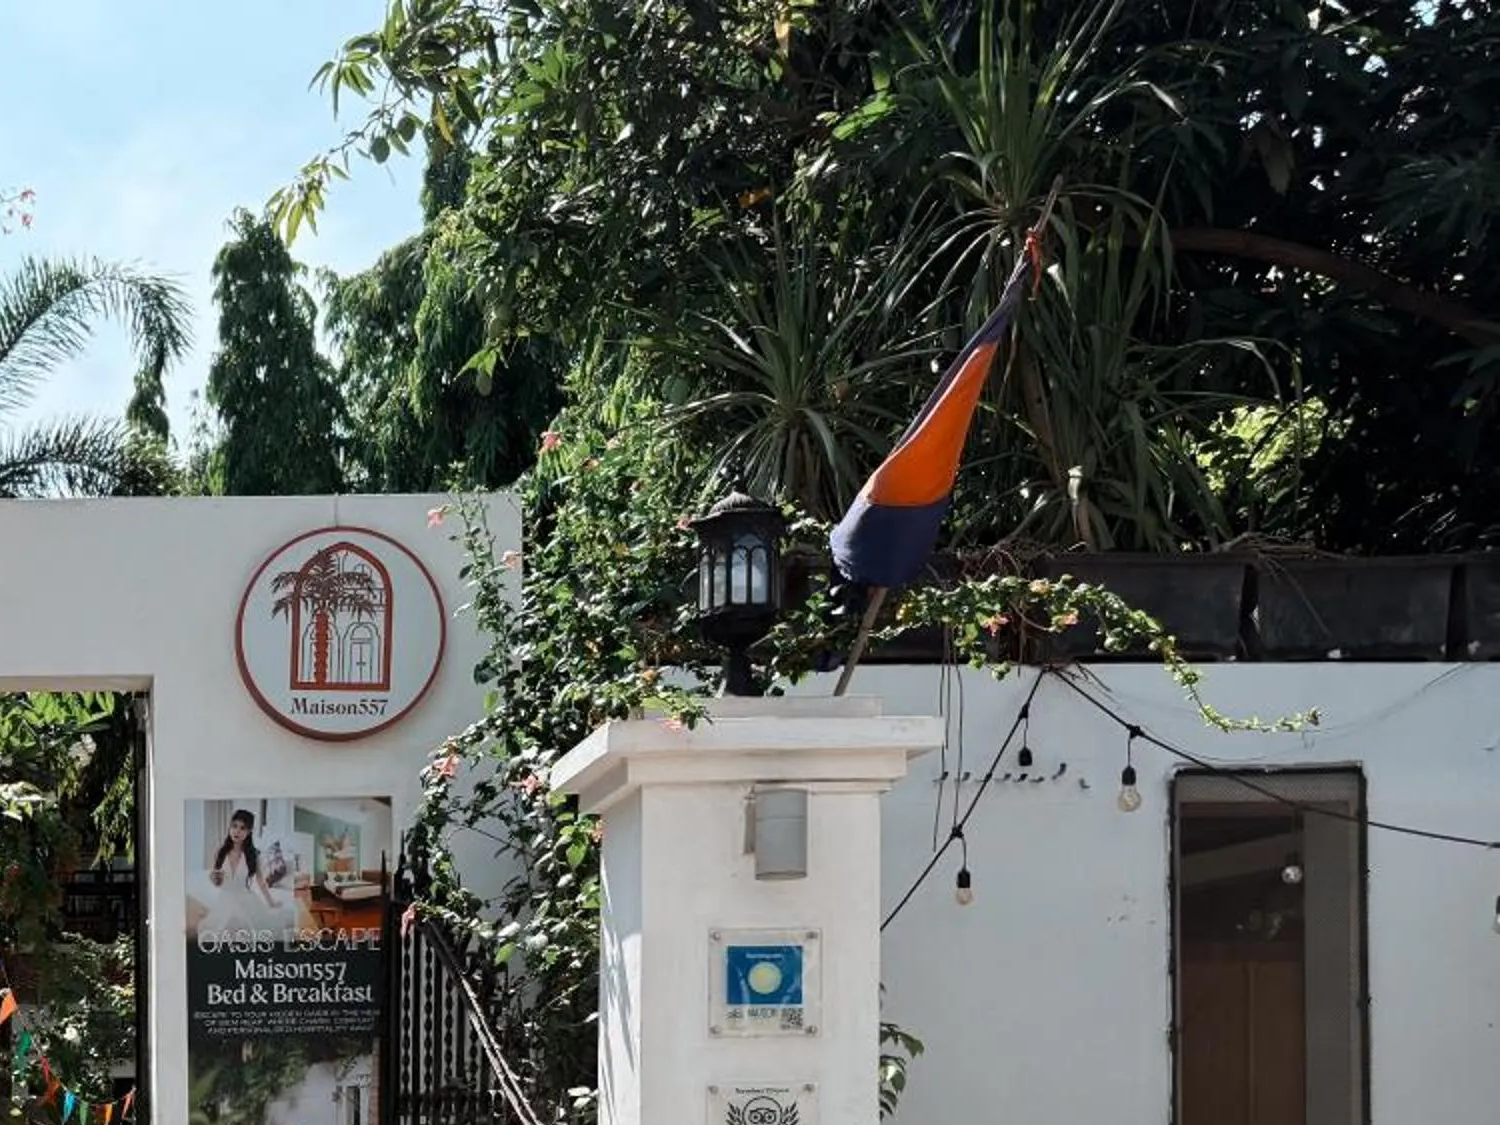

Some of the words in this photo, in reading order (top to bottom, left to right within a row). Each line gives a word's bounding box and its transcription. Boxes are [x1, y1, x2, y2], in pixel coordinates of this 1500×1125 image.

[290, 697, 389, 717] Maison557
[197, 928, 275, 953] OASIS
[282, 927, 381, 952] ESCAPE
[234, 958, 348, 985] Maison557
[207, 983, 246, 1005] Bed
[249, 984, 268, 1005] &
[272, 981, 374, 1004] Breakfast
